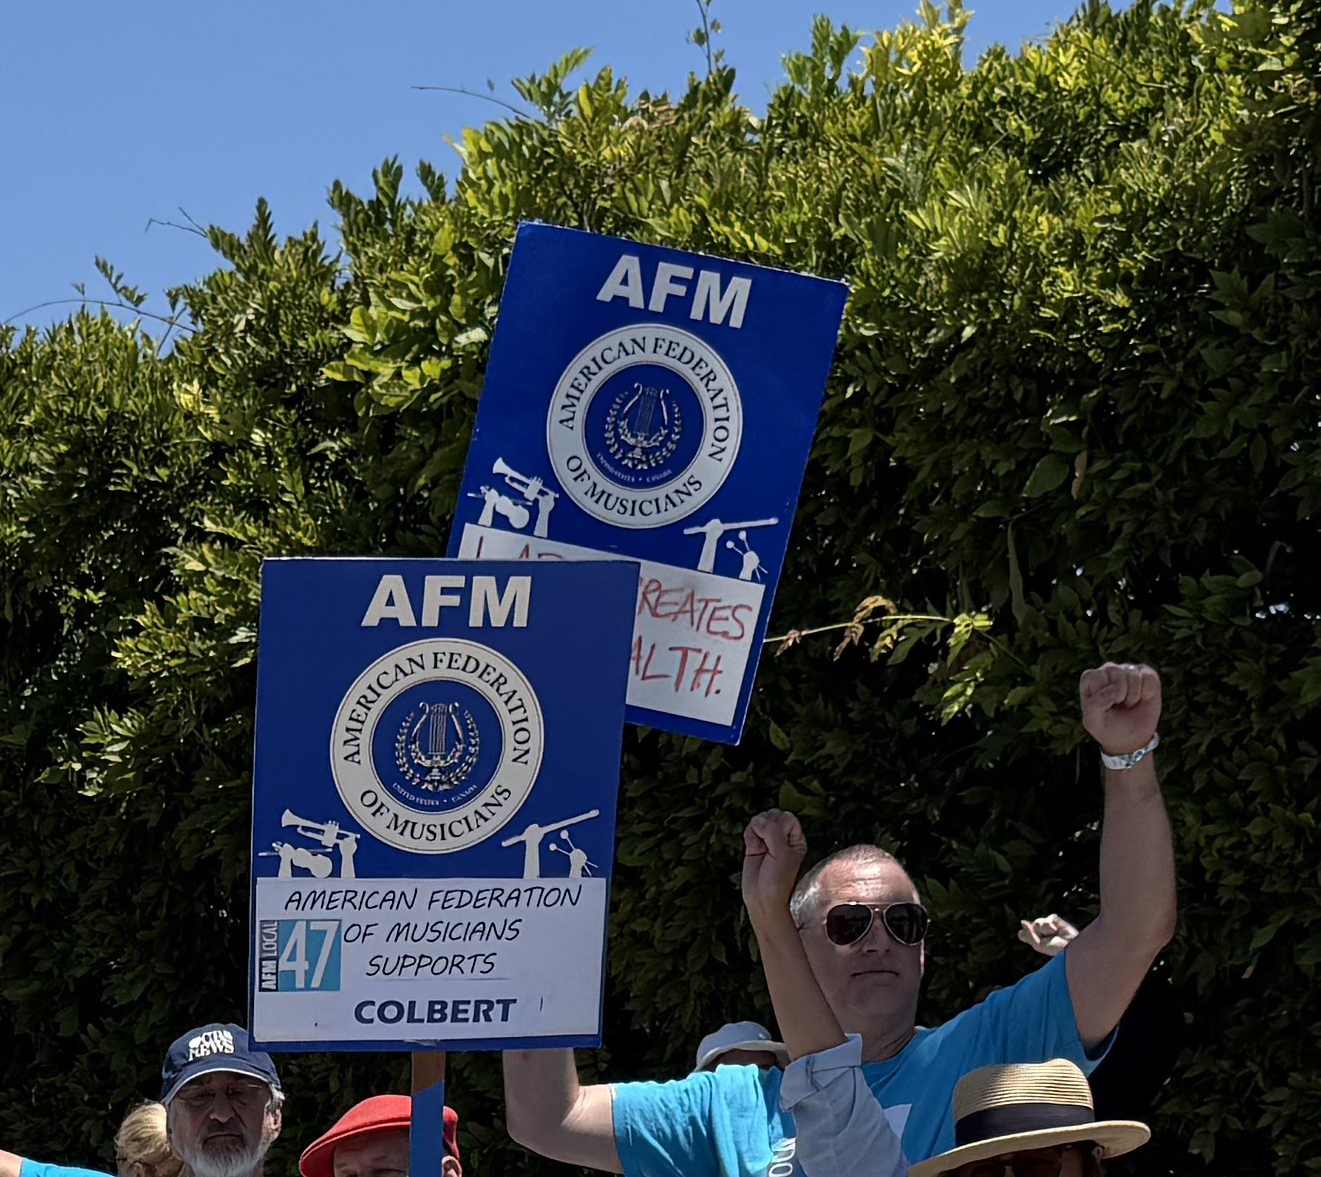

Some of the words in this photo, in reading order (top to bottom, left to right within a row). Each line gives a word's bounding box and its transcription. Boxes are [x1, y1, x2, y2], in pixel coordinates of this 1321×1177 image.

[596, 254, 752, 329] AFM
[564, 336, 647, 431] AMERICAN
[652, 336, 732, 463] FEDERATION
[566, 455, 592, 487] OF
[589, 473, 703, 517] MUSICIANS
[360, 574, 532, 628] AFM
[639, 578, 753, 640] REATES
[343, 651, 426, 766] AMERICAN
[432, 651, 533, 766] FEDERATION
[359, 787, 388, 820] OF
[386, 784, 513, 842] MUSICIANS
[284, 887, 418, 912] AMERICAN
[428, 884, 582, 911] FEDERATION
[261, 919, 277, 957] LOCAL
[279, 920, 340, 989] 47
[343, 923, 379, 944] OF
[386, 918, 522, 943] MUSICIANS
[261, 960, 277, 990] AFM
[365, 953, 497, 977] SUPPORTS
[354, 999, 517, 1024] COLBERT
